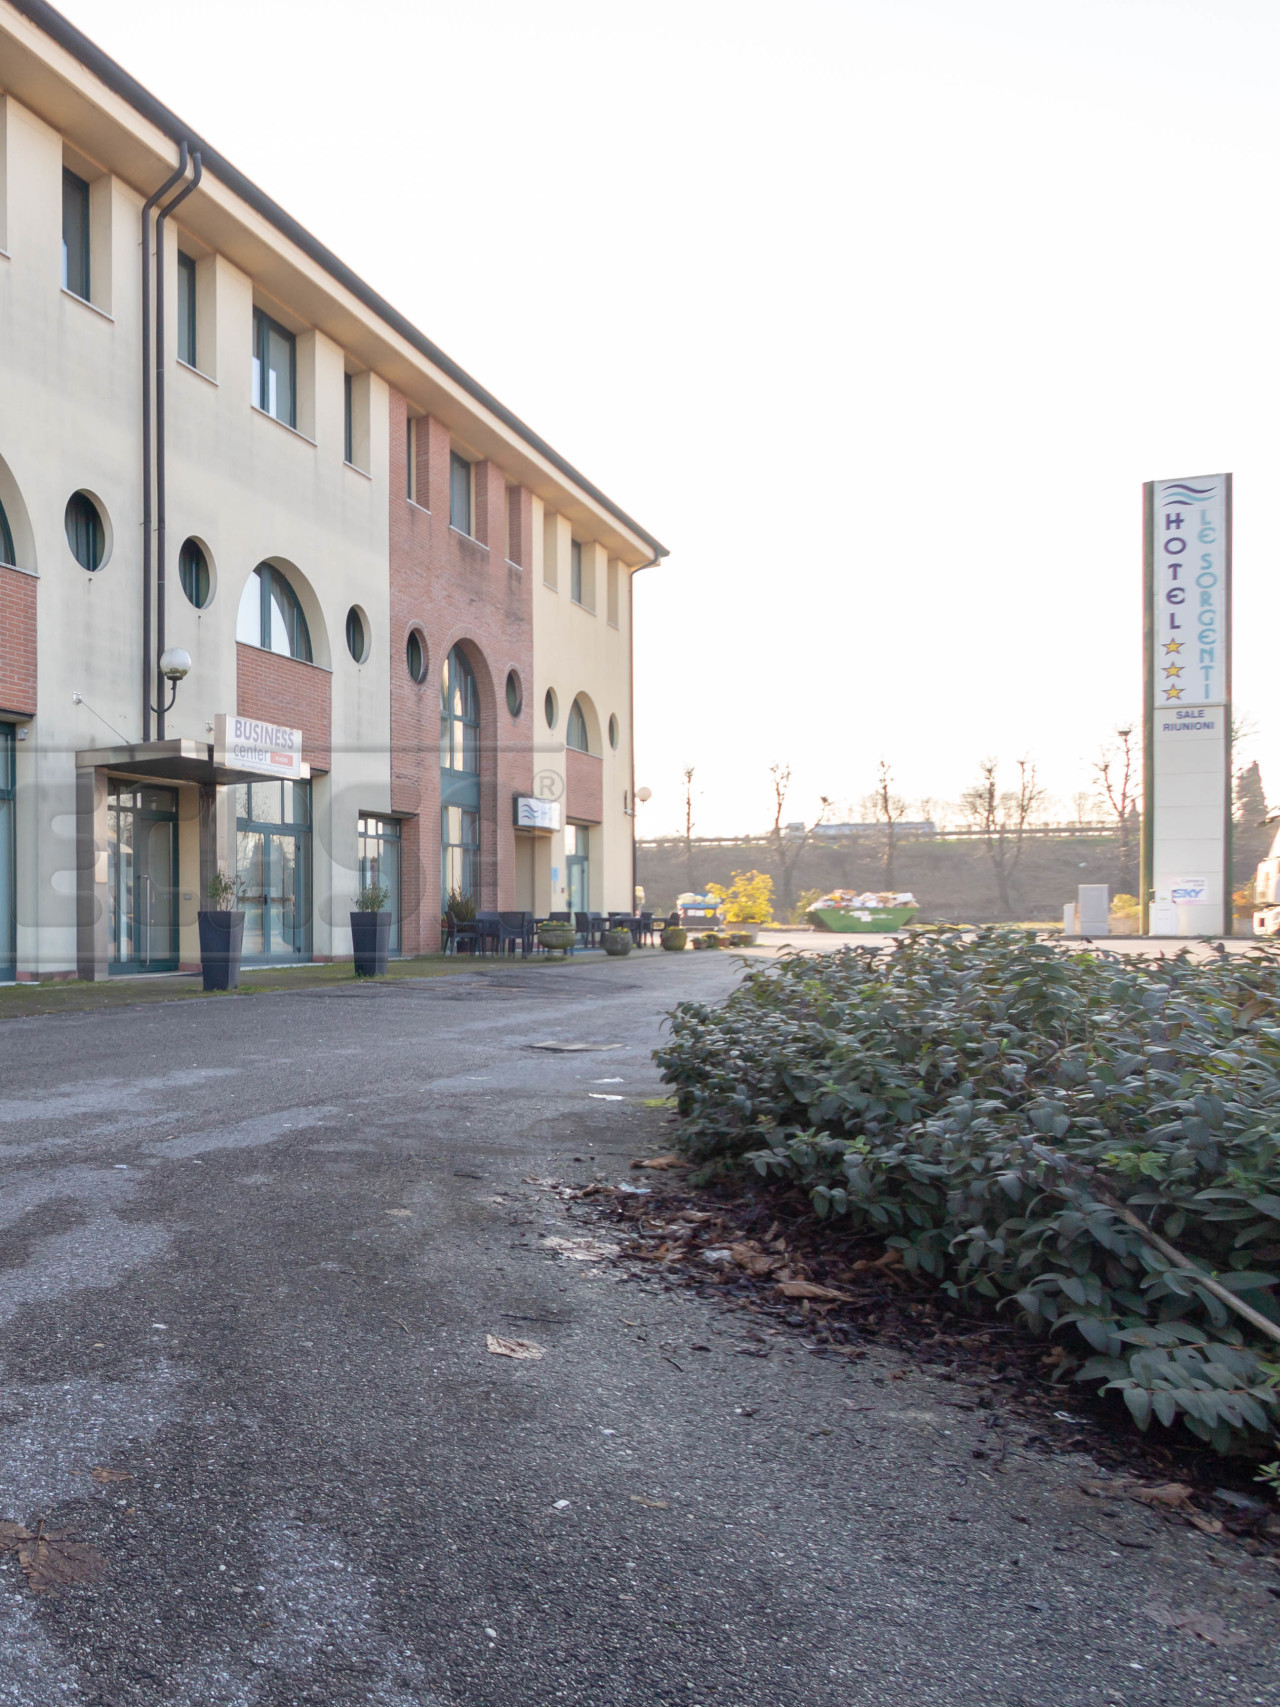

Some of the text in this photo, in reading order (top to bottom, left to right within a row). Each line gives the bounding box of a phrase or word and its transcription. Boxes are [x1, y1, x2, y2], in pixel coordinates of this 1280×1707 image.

[1163, 512, 1187, 630] HOTEL
[1195, 509, 1218, 699] LE SORGENTI
[1176, 709, 1206, 720] SALE
[234, 719, 294, 750] BUSINESS
[1163, 721, 1215, 732] RIUNIONI
[233, 744, 269, 762] center
[1173, 889, 1204, 898] SKY
